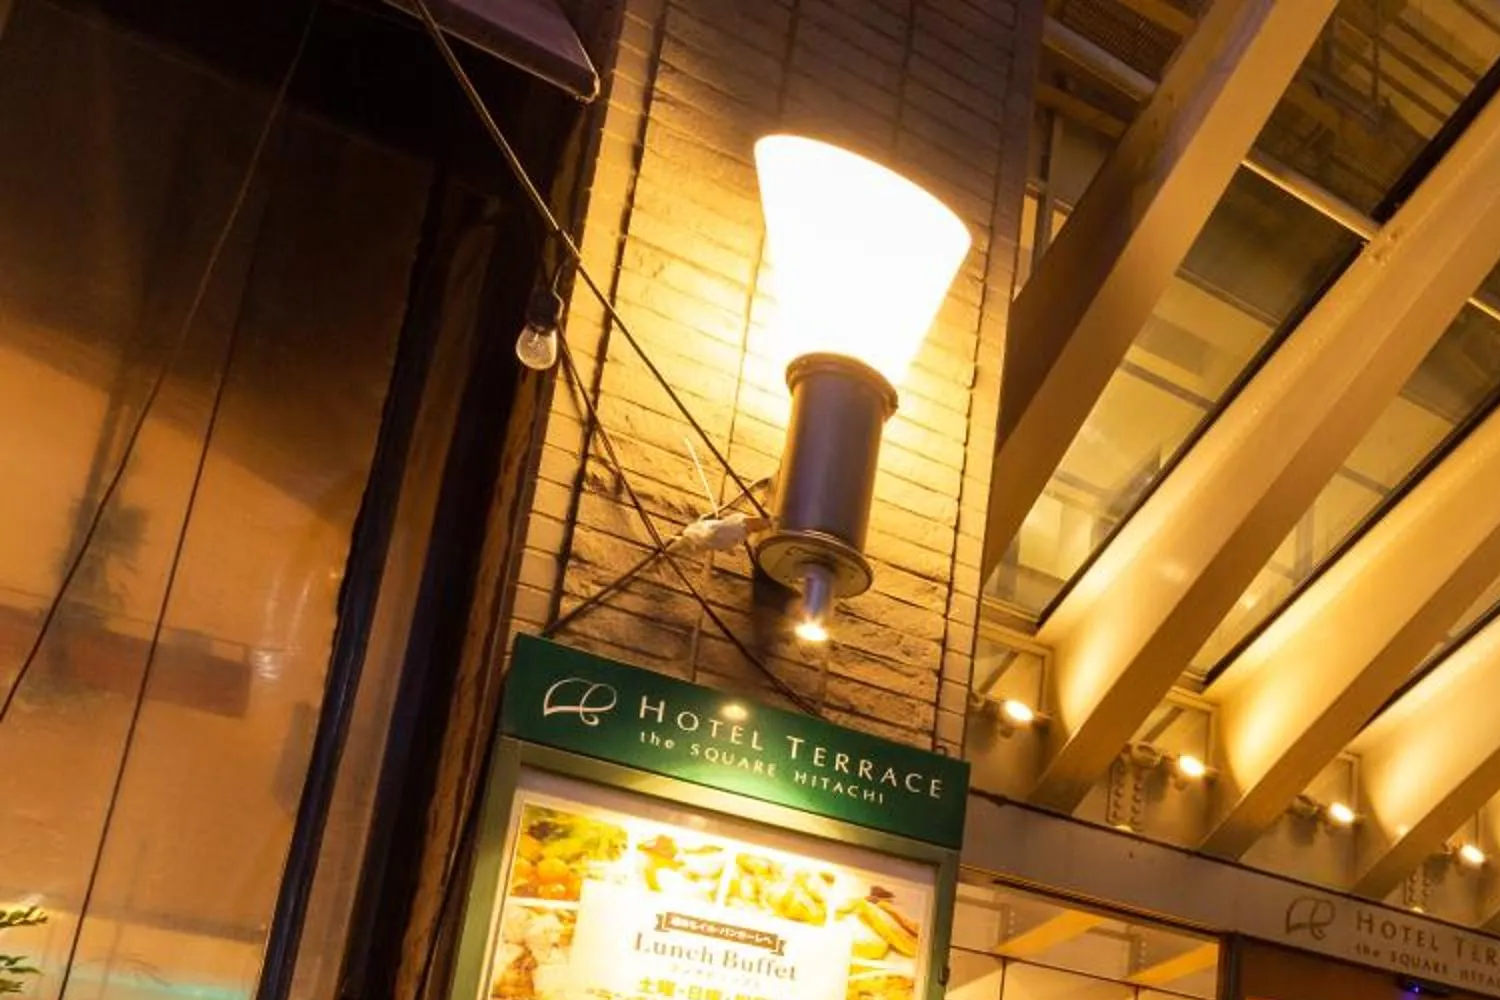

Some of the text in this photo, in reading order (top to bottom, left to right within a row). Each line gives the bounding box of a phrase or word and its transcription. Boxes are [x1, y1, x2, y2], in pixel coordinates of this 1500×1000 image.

[639, 695, 944, 799] HOTEL TERRACE
[640, 731, 885, 805] the SQUARE HITACHI
[633, 931, 714, 966] Lunch
[722, 949, 797, 981] Buffet
[1355, 909, 1440, 953] HOTEL
